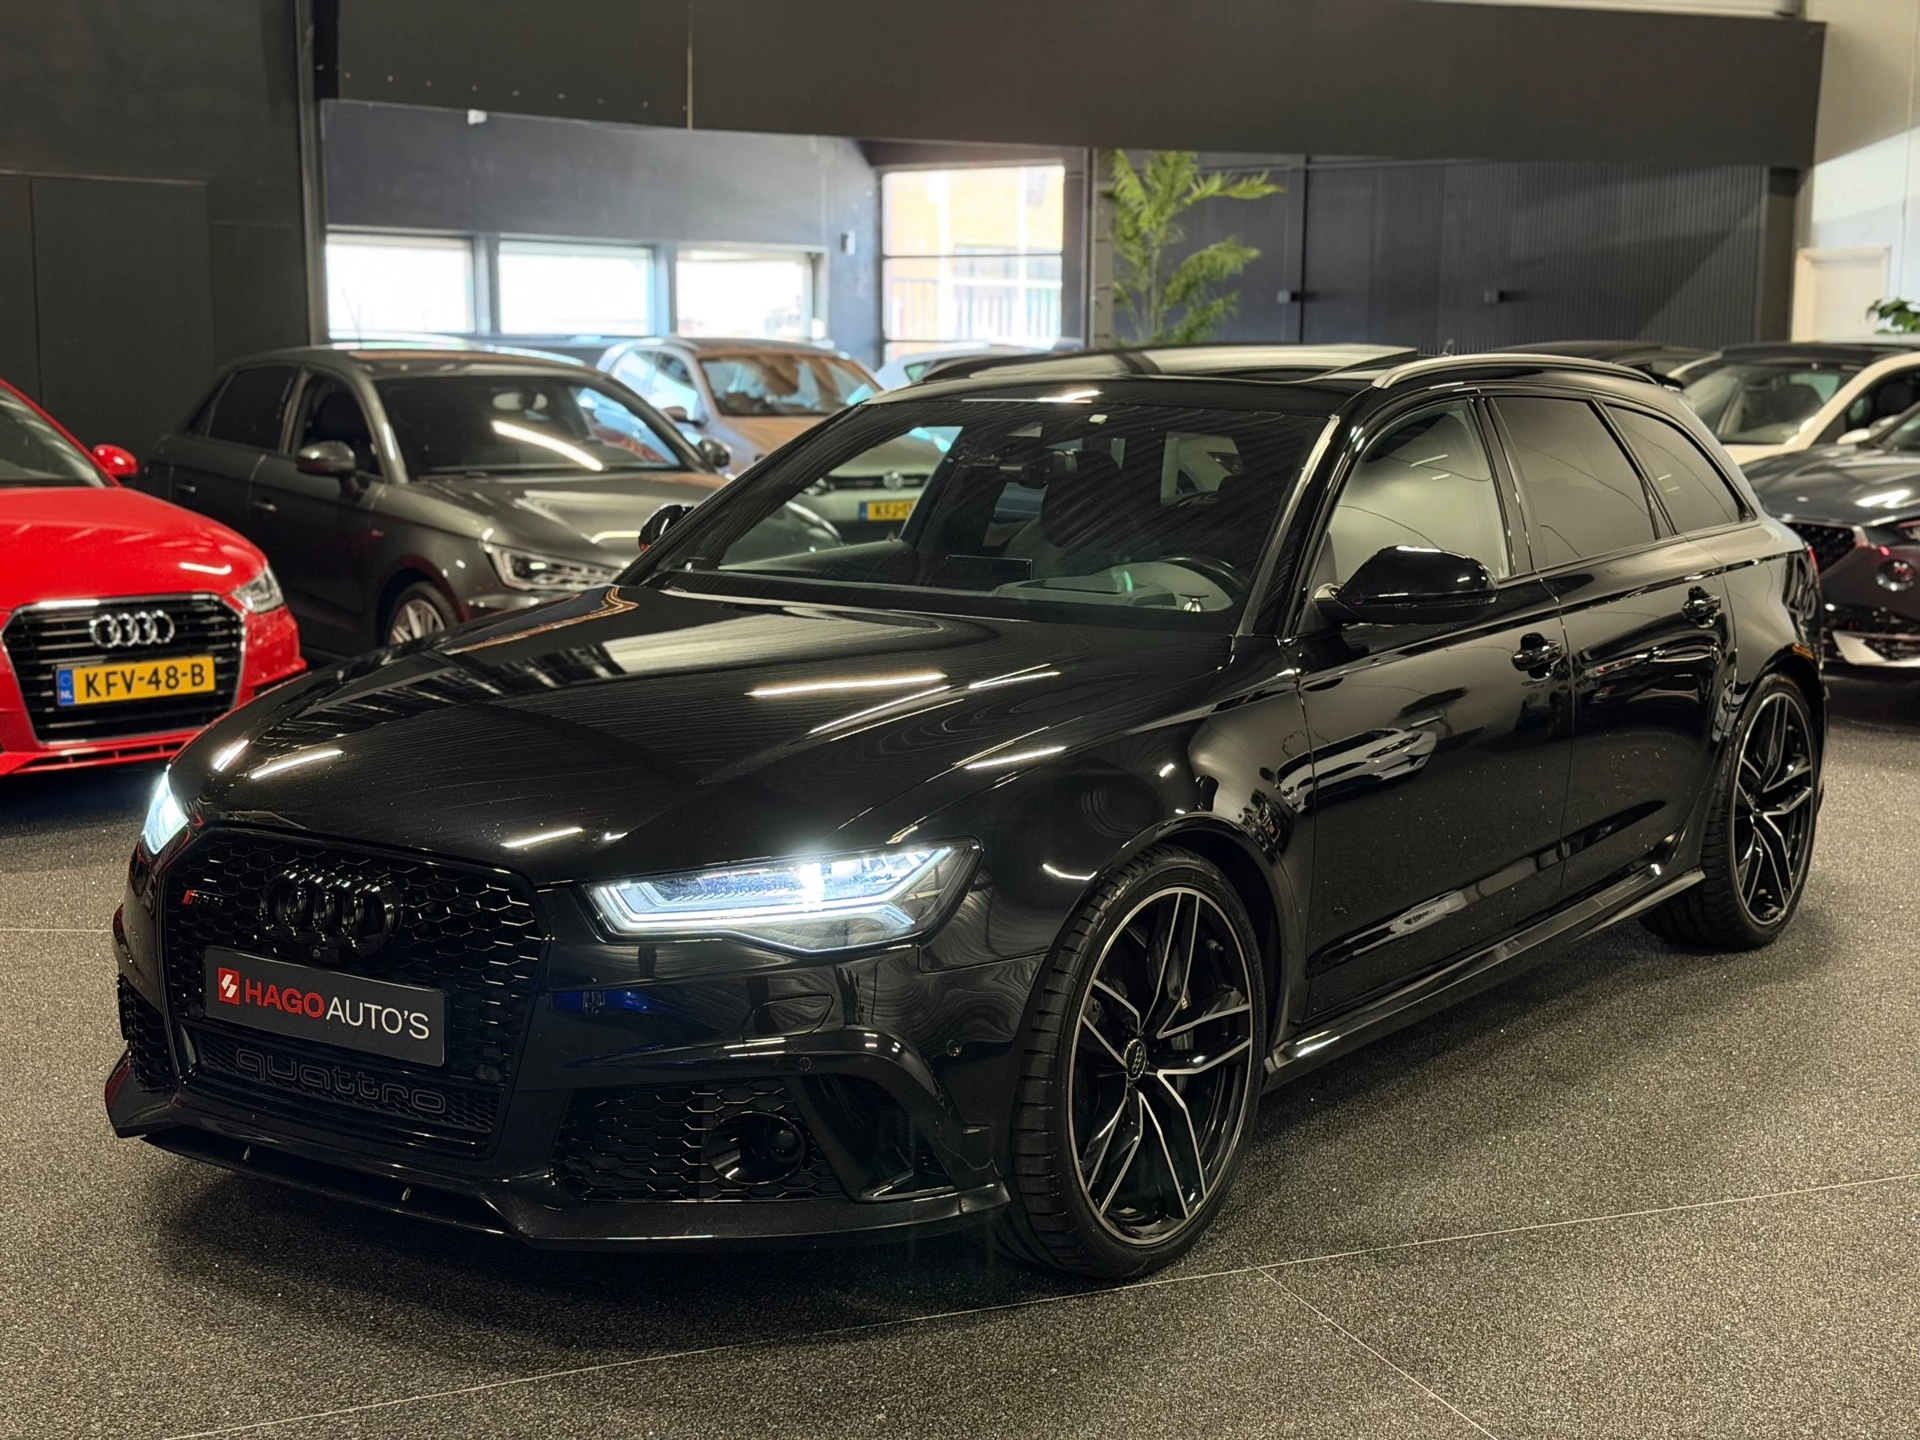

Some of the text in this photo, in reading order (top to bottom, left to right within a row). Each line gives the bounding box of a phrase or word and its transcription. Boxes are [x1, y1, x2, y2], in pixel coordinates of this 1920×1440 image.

[60, 690, 73, 699] NL
[85, 663, 205, 698] KFV-48-B
[236, 1049, 446, 1114] quattro
